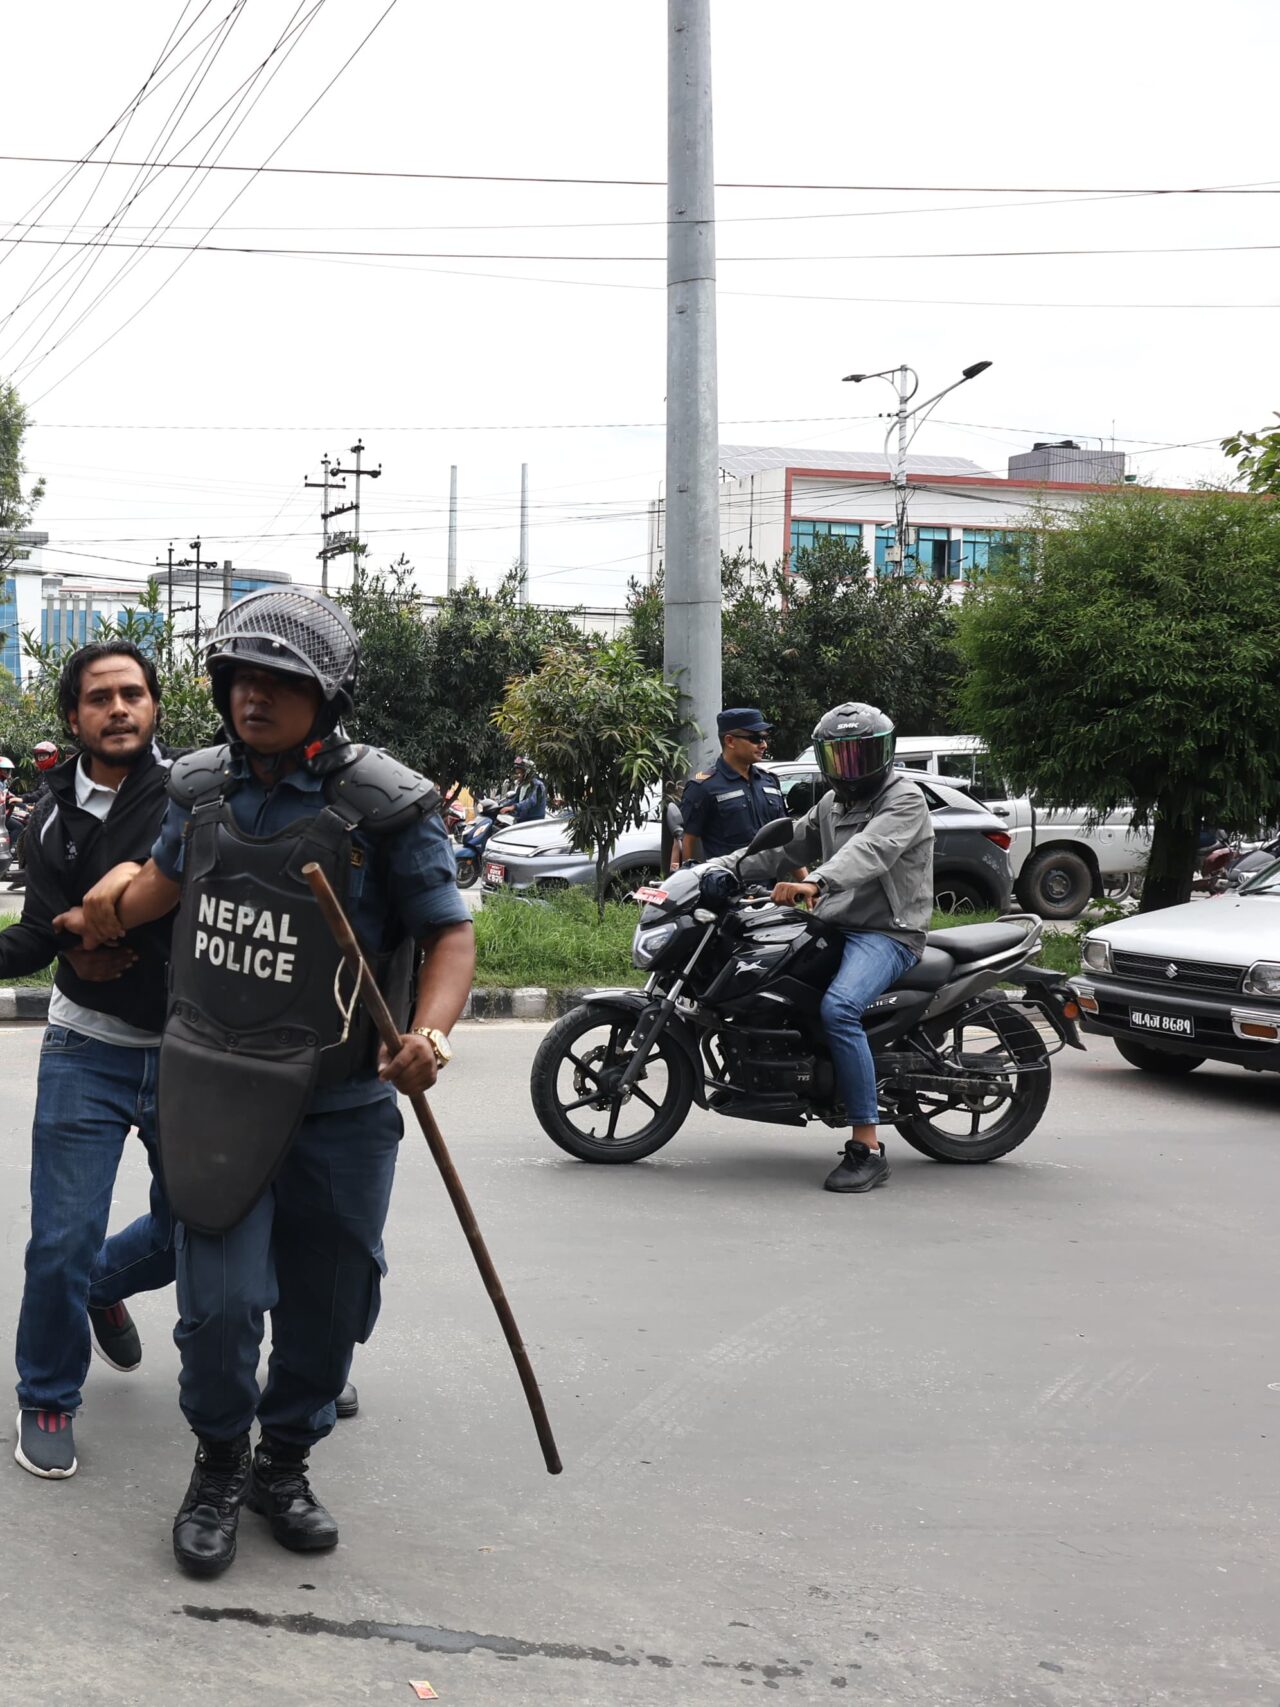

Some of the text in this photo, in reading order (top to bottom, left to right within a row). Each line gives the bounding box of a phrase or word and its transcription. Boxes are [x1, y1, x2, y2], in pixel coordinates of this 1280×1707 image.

[837, 722, 859, 730] SMK
[198, 894, 298, 945] NEPAL
[195, 930, 295, 983] POLICE
